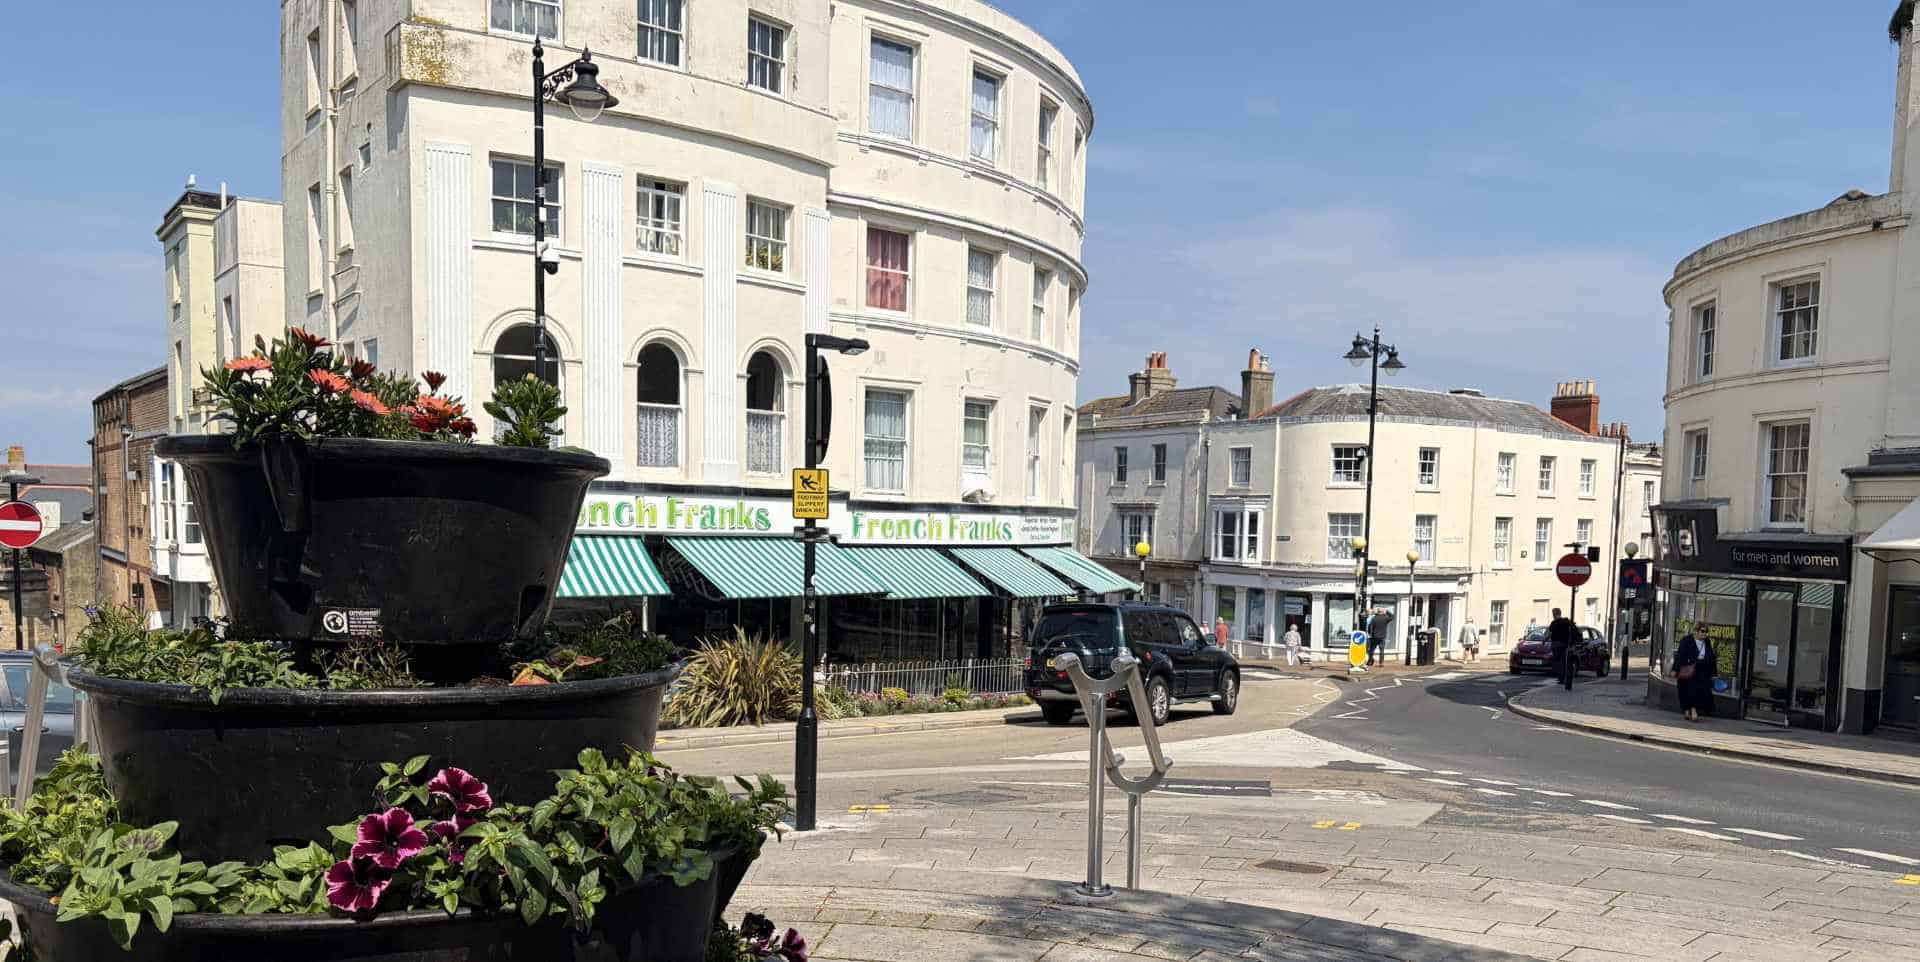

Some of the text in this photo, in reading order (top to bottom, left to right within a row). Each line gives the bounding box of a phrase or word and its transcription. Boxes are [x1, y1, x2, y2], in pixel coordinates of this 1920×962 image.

[577, 496, 772, 531] nch Franks
[851, 511, 1013, 541] French Franks
[1732, 548, 1839, 566] for men and women
